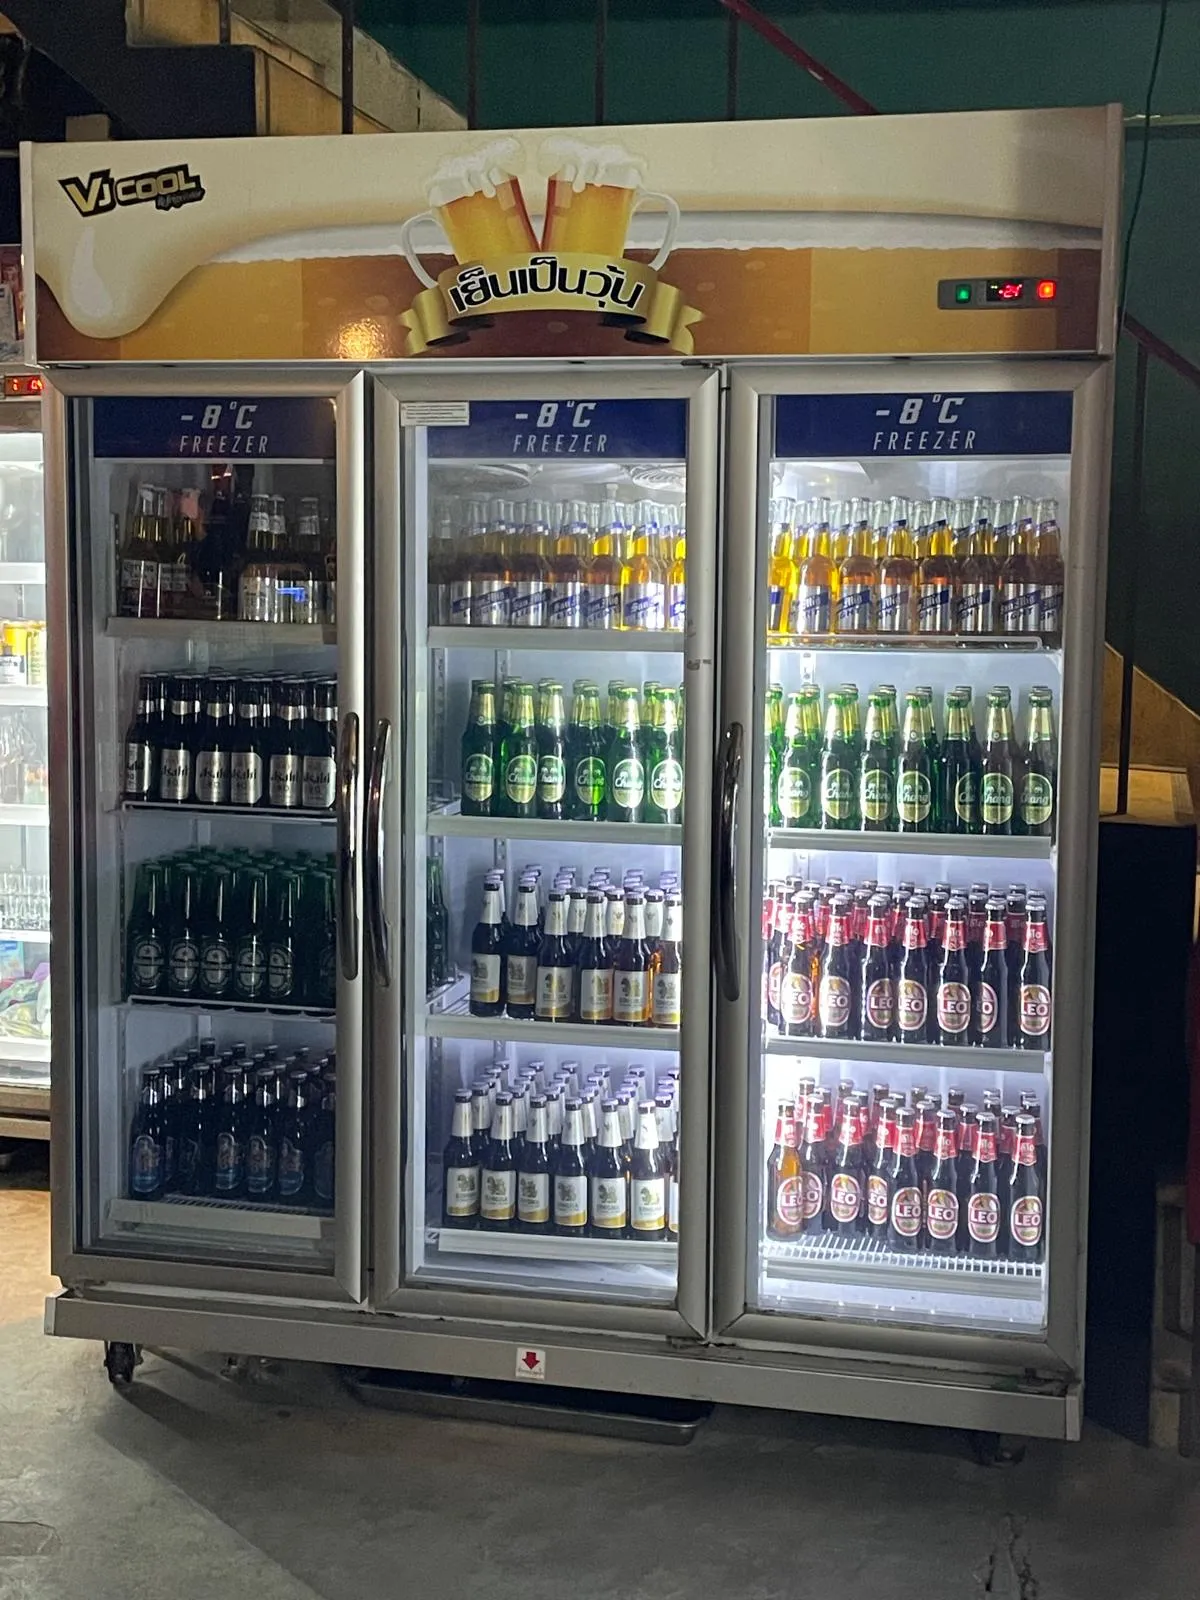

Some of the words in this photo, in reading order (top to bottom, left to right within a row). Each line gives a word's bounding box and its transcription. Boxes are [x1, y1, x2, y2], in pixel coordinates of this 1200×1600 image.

[115, 169, 197, 203] COOL
[449, 256, 645, 312] เย็นเป็นวุ้น
[180, 435, 268, 453] FREEZER
[513, 434, 608, 453] FREEZER
[873, 430, 976, 450] FREEZER
[791, 992, 810, 1005] EO
[826, 994, 848, 1007] EO
[940, 1000, 968, 1014] LEO
[1020, 1002, 1049, 1016] LEO
[832, 1190, 857, 1205] LEO
[895, 1203, 922, 1218] LEO
[928, 1206, 955, 1221] LEO
[970, 1208, 998, 1224] LEO
[1014, 1213, 1041, 1227] LEO
